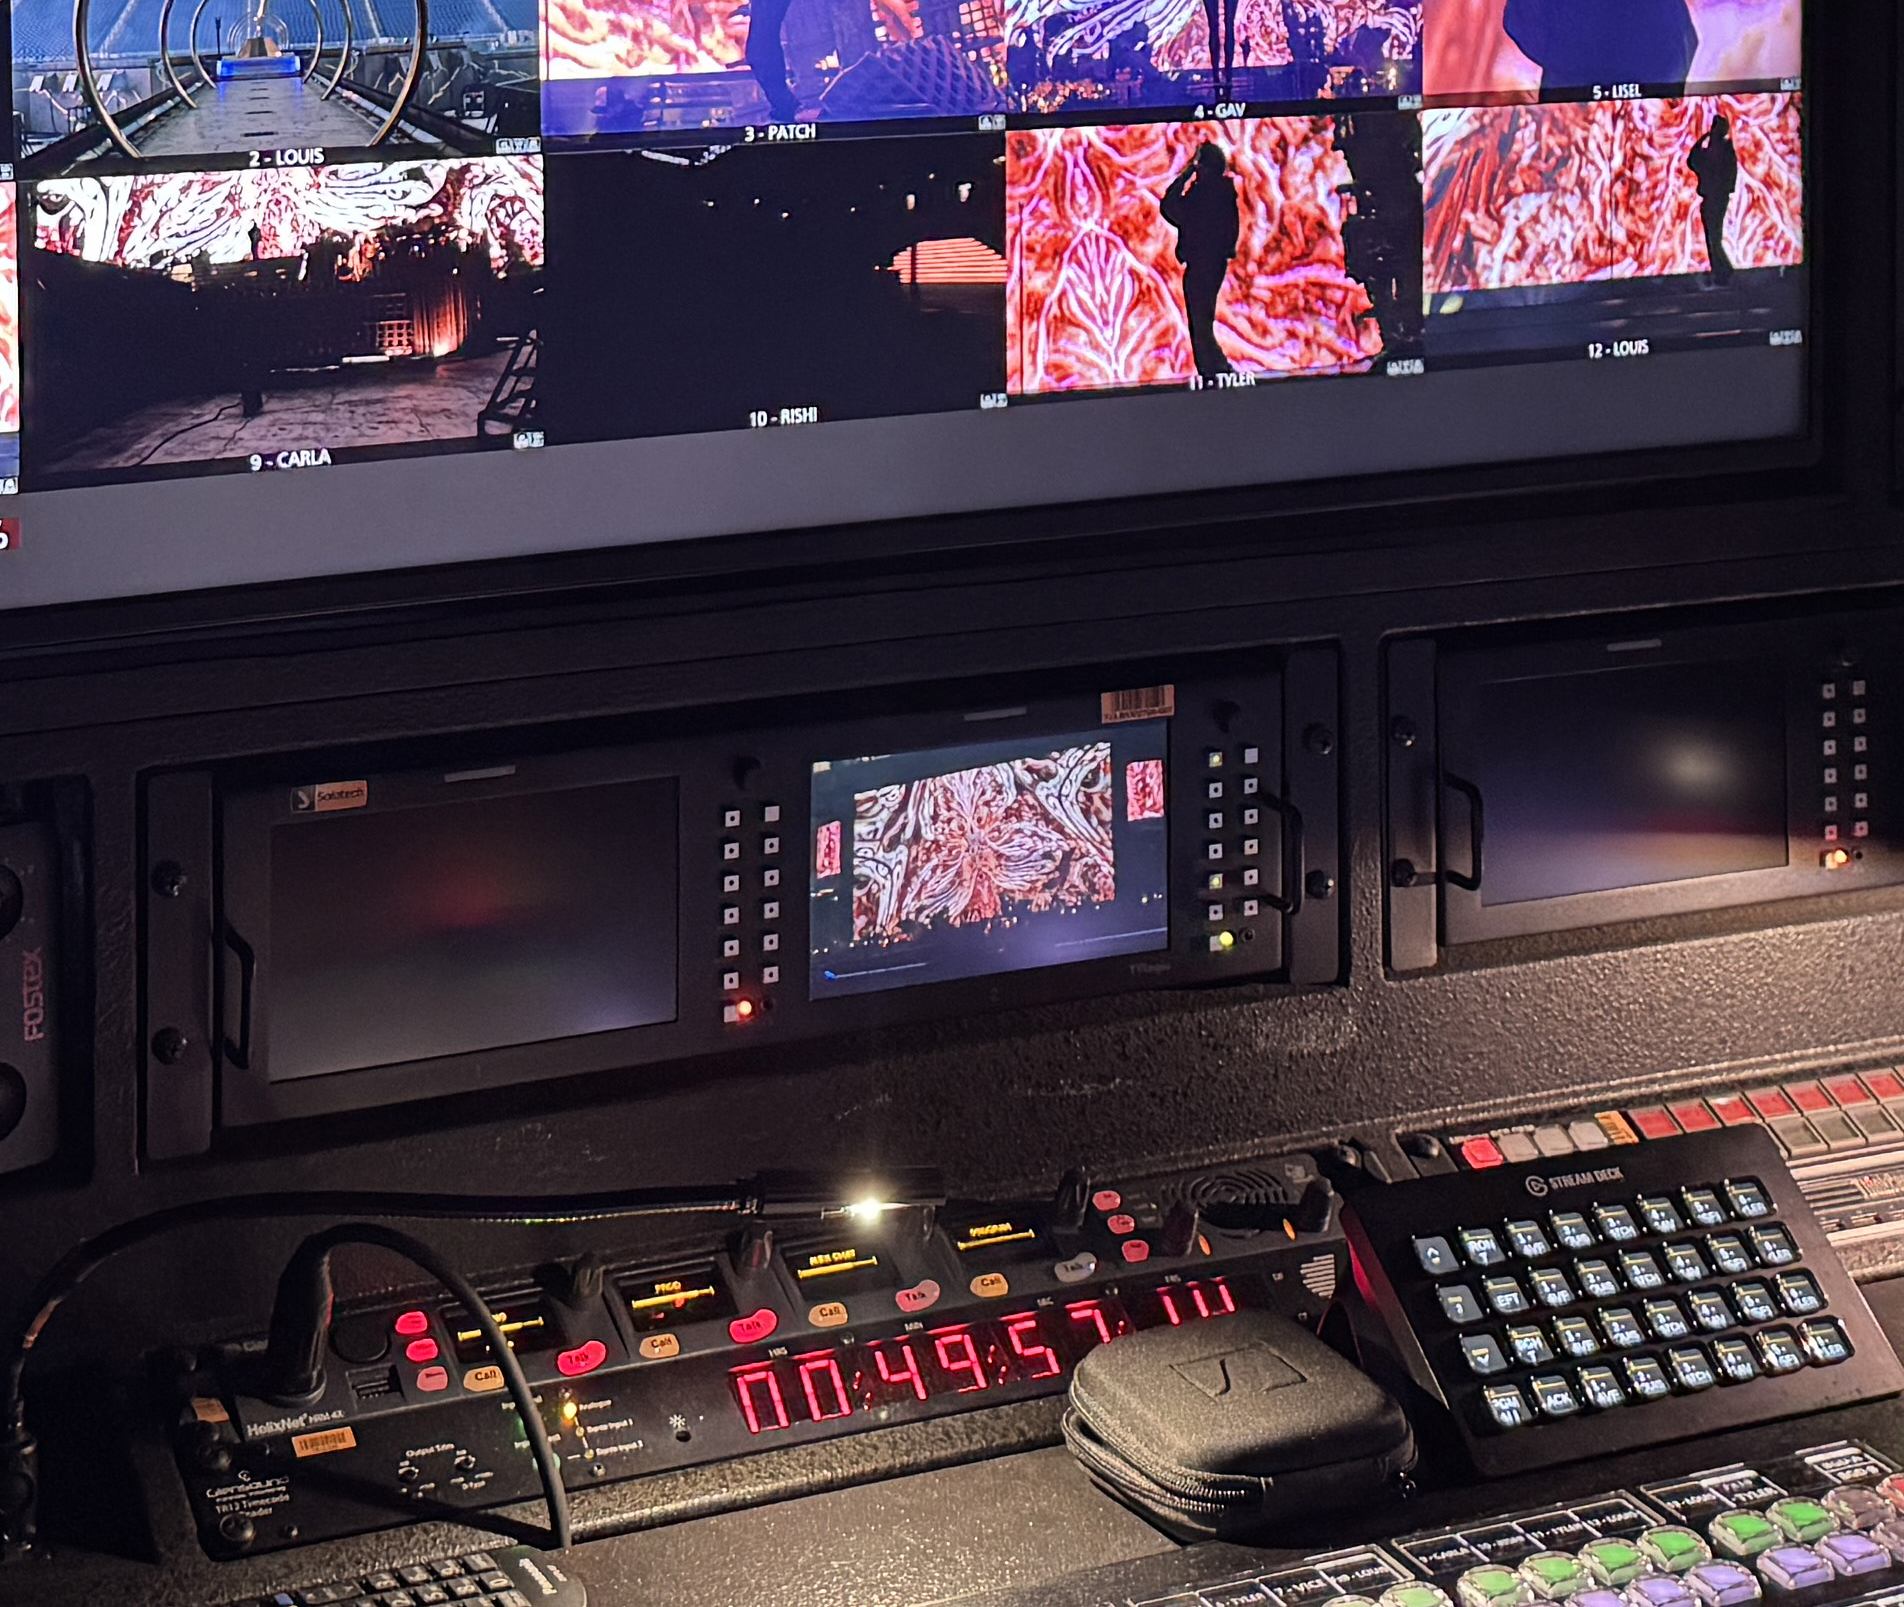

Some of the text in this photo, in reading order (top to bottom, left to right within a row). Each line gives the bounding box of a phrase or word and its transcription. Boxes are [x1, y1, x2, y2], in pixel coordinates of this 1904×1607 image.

[1592, 85, 1602, 100] 5
[1612, 83, 1643, 99] LISEL
[1194, 104, 1205, 119] 4
[1215, 103, 1247, 119] GAV
[745, 125, 755, 142] 3
[768, 121, 817, 141] PATCH
[249, 149, 260, 166] 2
[275, 146, 325, 166] LOUIS
[1588, 341, 1602, 358] 12
[1613, 339, 1649, 357] LOUIS
[780, 406, 818, 425] RISHI
[250, 452, 261, 470] 9
[276, 447, 331, 469] CARLA
[1549, 1166, 1624, 1190] STREAM DECK
[475, 1370, 497, 1382] Call
